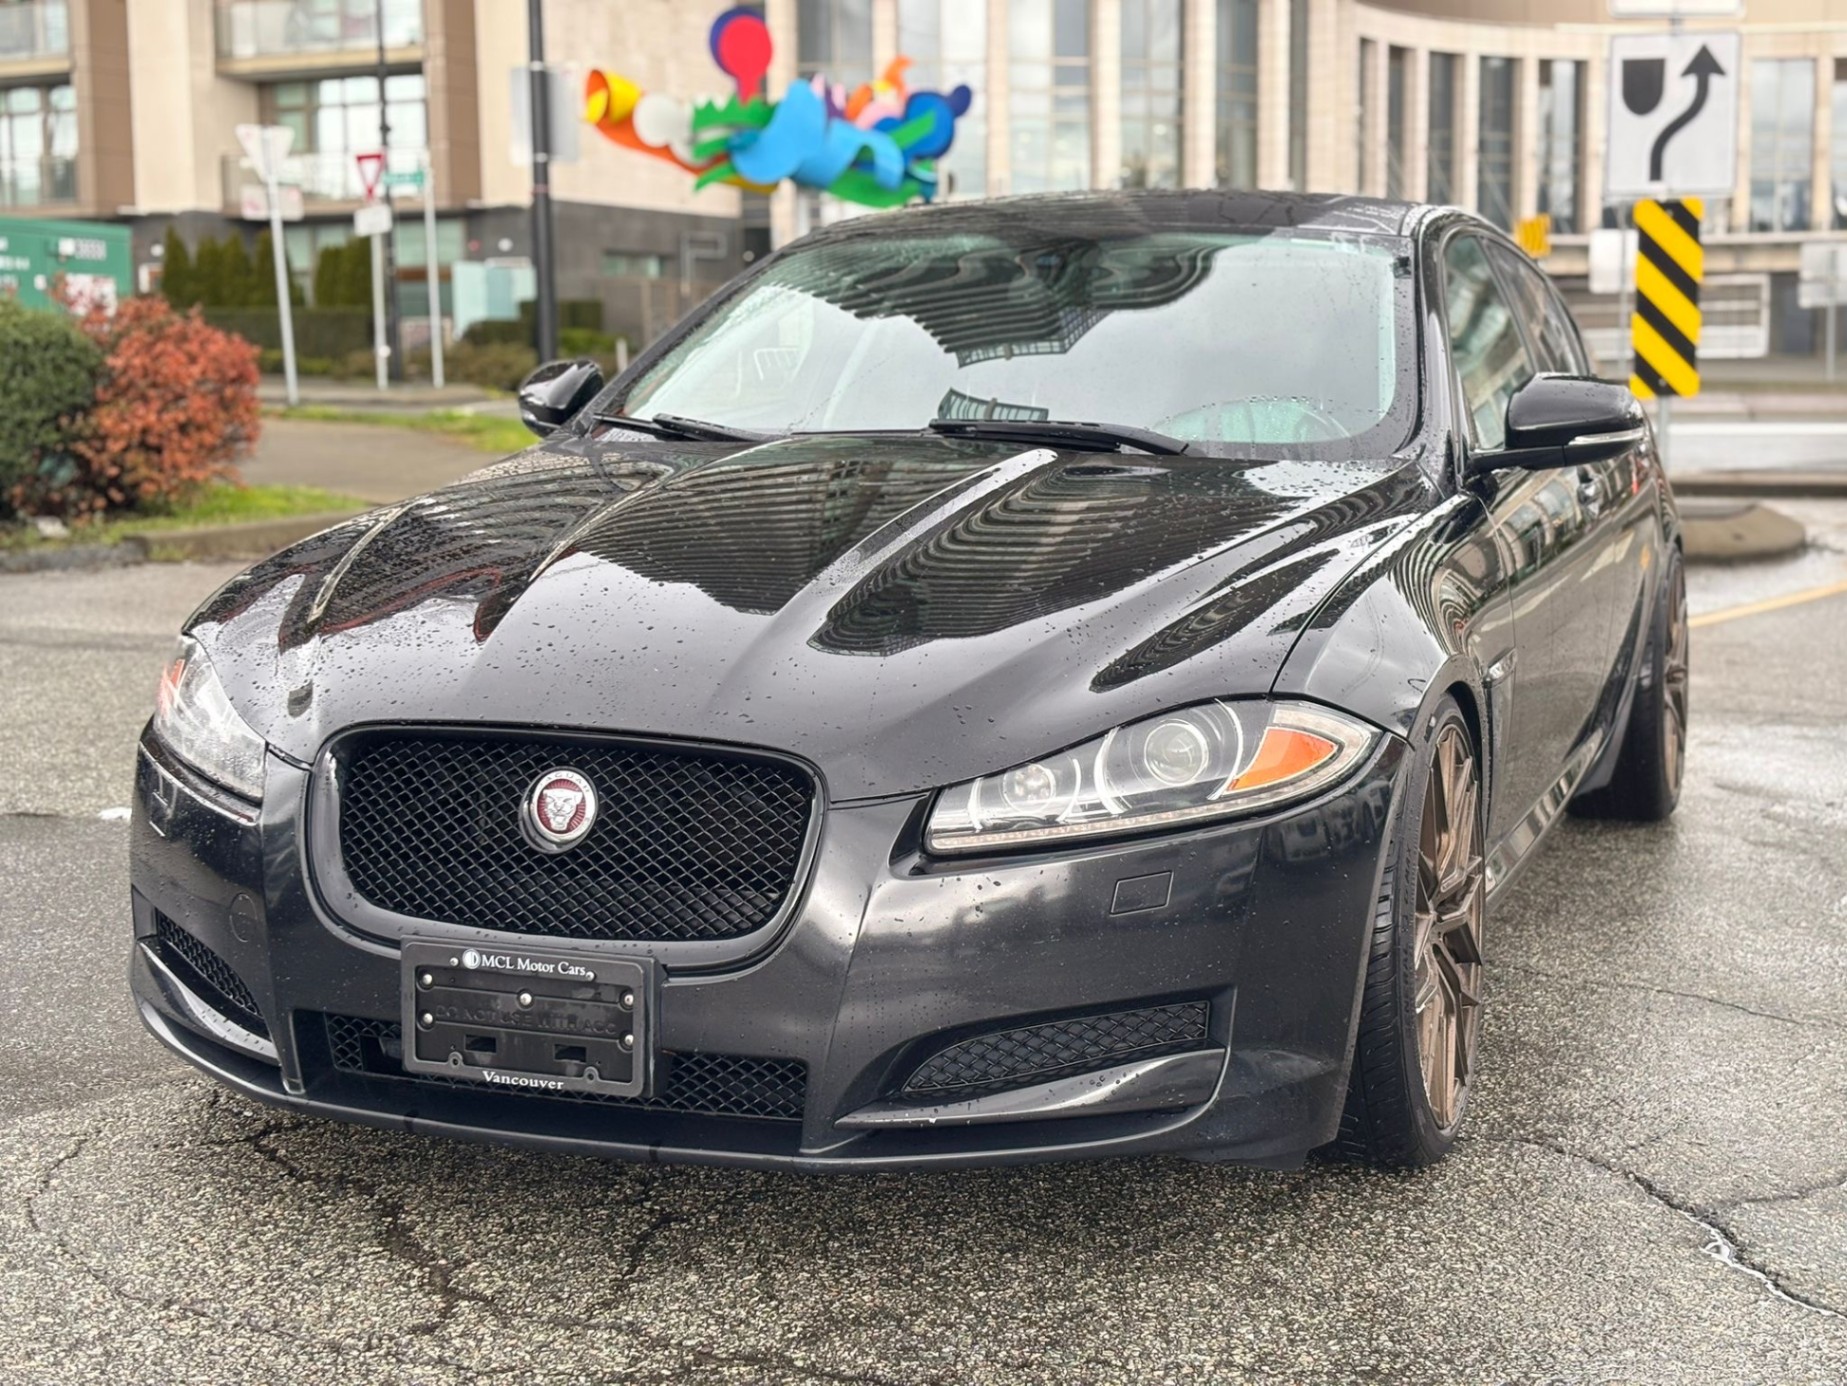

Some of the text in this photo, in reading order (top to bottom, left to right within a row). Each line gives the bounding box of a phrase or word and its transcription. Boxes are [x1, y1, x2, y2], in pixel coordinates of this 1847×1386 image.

[539, 772, 590, 792] AGUAR
[481, 954, 586, 977] MCL Motor Cars
[482, 1070, 564, 1090] Vancouver
